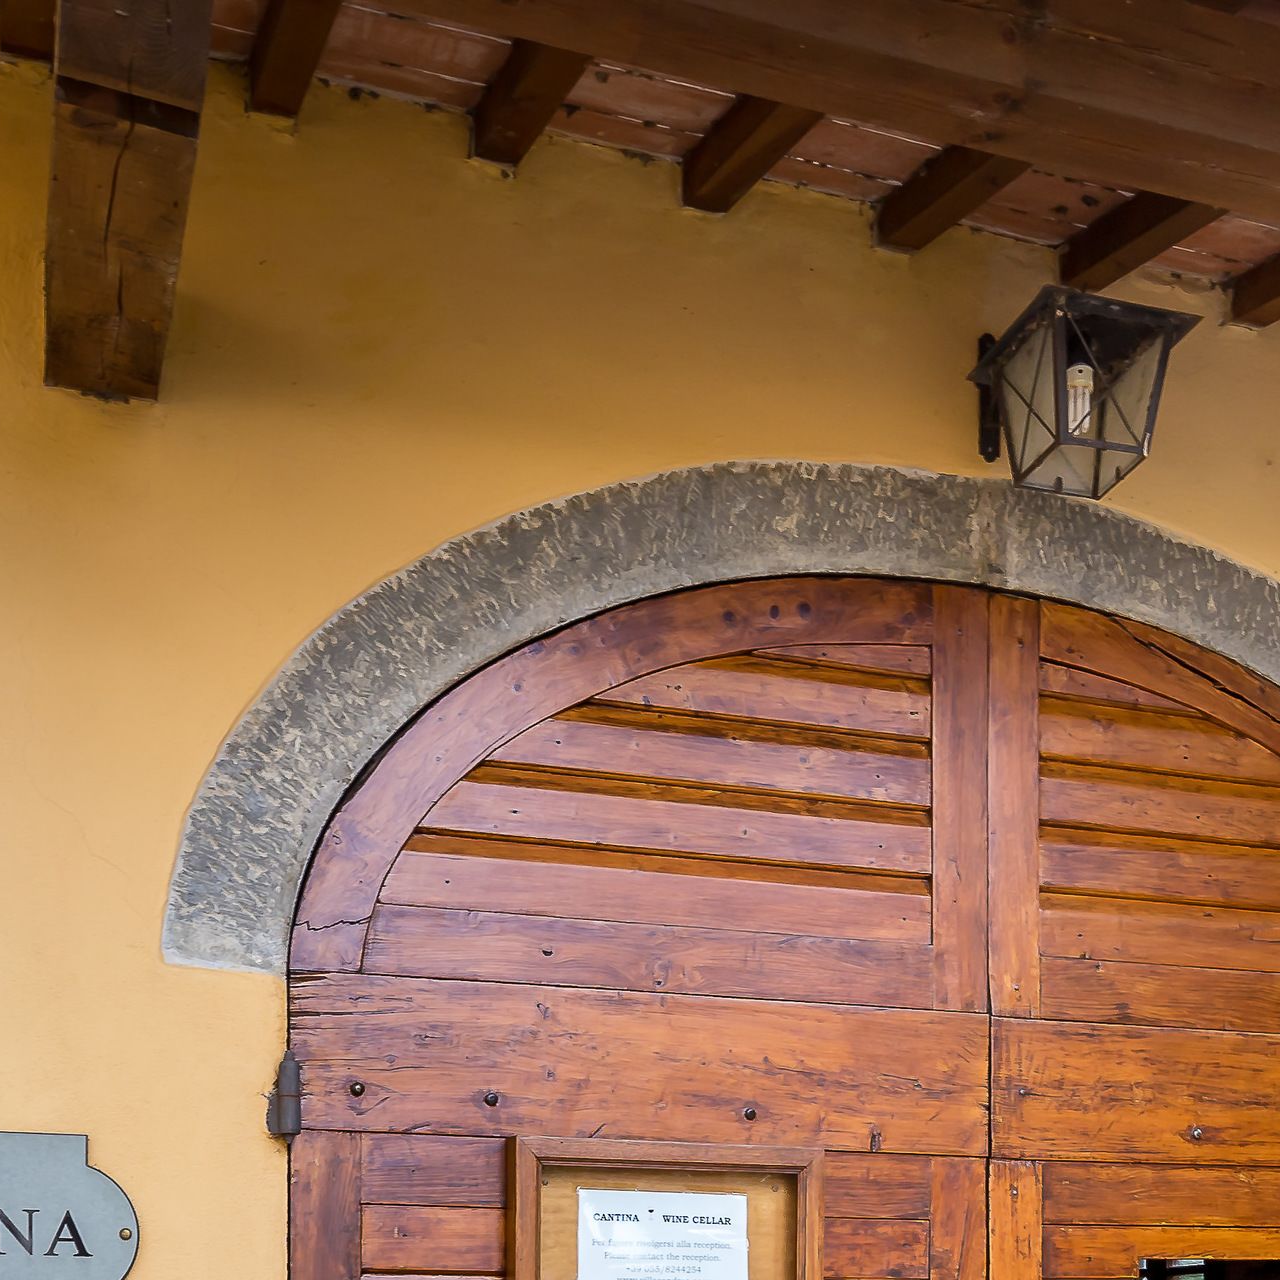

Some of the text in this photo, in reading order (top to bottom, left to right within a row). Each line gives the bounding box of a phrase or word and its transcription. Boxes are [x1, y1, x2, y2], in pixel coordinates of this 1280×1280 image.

[593, 1213, 732, 1226] CANTINA WINE CELLAR
[676, 1240, 691, 1248] alla
[633, 1253, 664, 1261] tact
[666, 1253, 680, 1261] the
